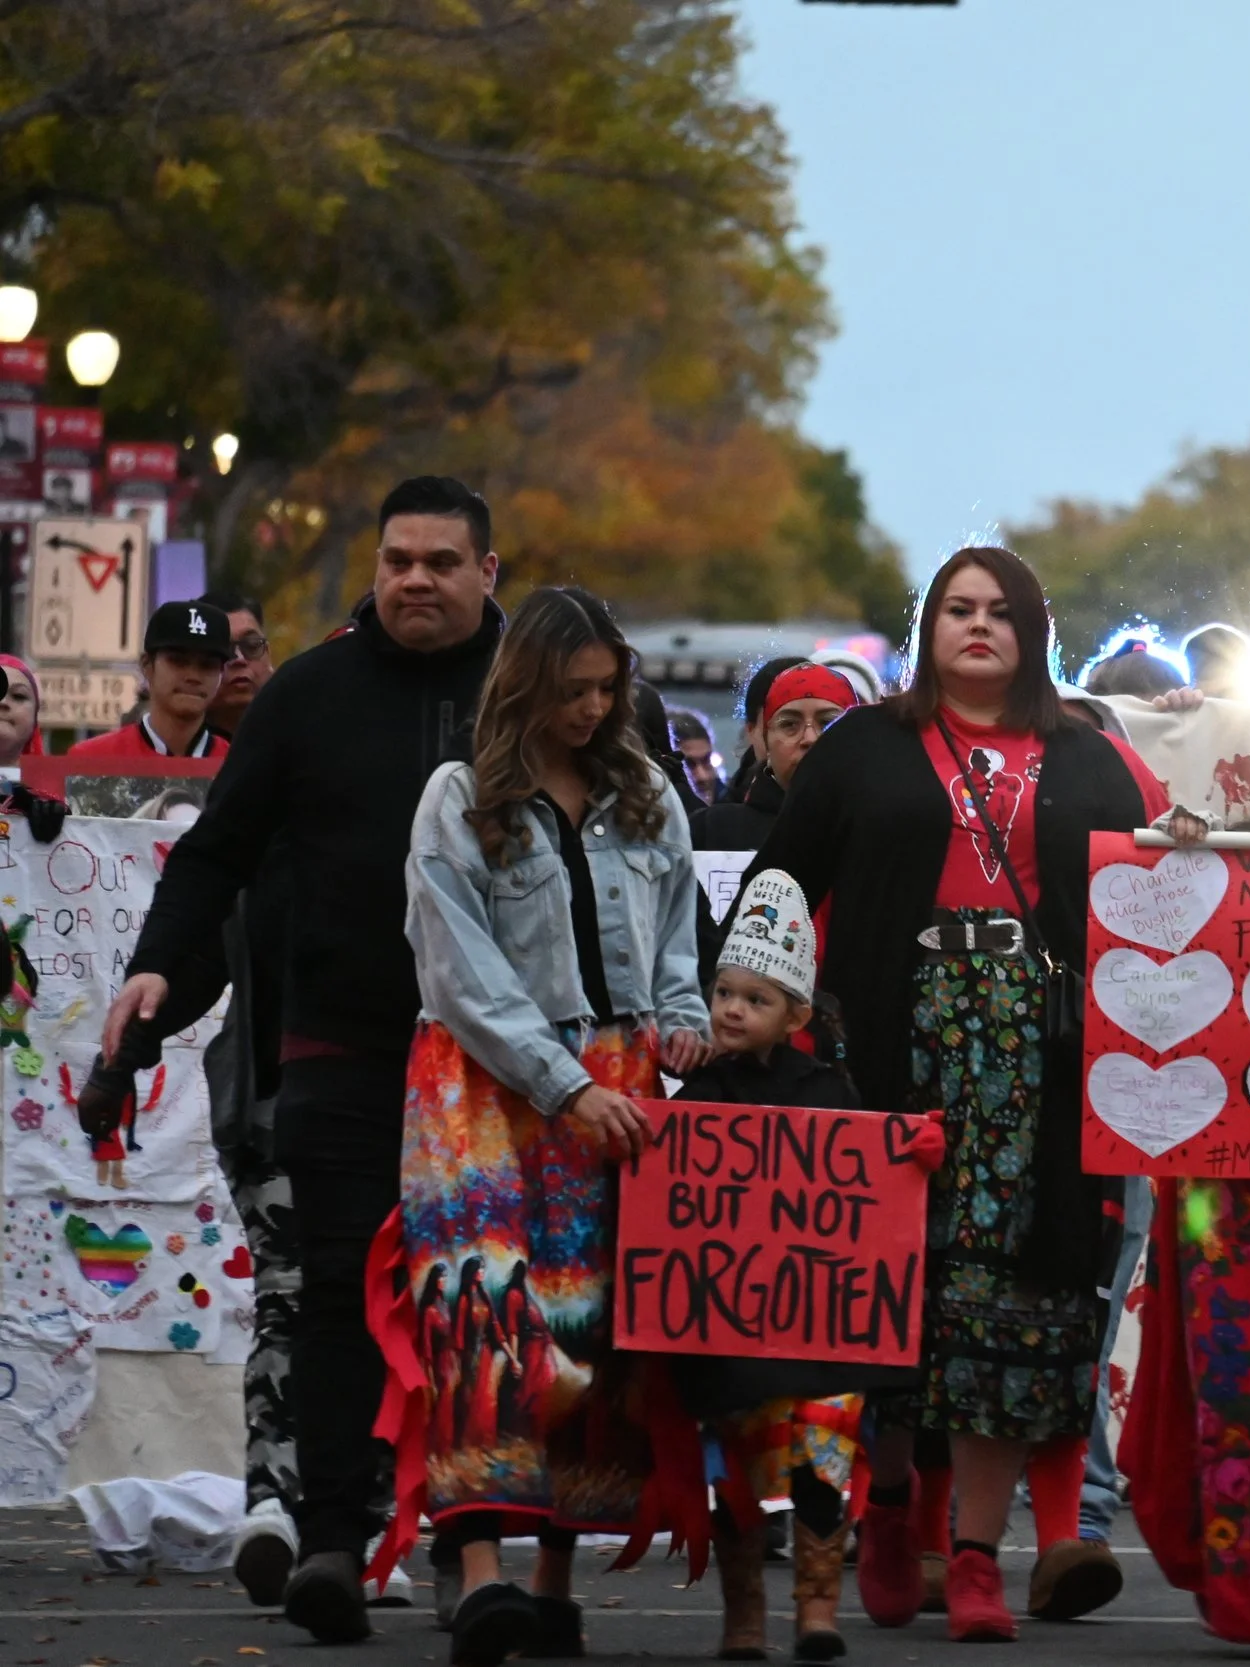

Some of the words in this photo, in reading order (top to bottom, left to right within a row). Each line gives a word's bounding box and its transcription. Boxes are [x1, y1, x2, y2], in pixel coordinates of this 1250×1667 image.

[188, 608, 207, 635] LA
[35, 907, 95, 938] FOR
[630, 1111, 871, 1188] MISSING
[669, 1181, 749, 1230] BUT
[771, 1187, 879, 1244] NOT
[624, 1240, 918, 1353] FORGOTTEN
